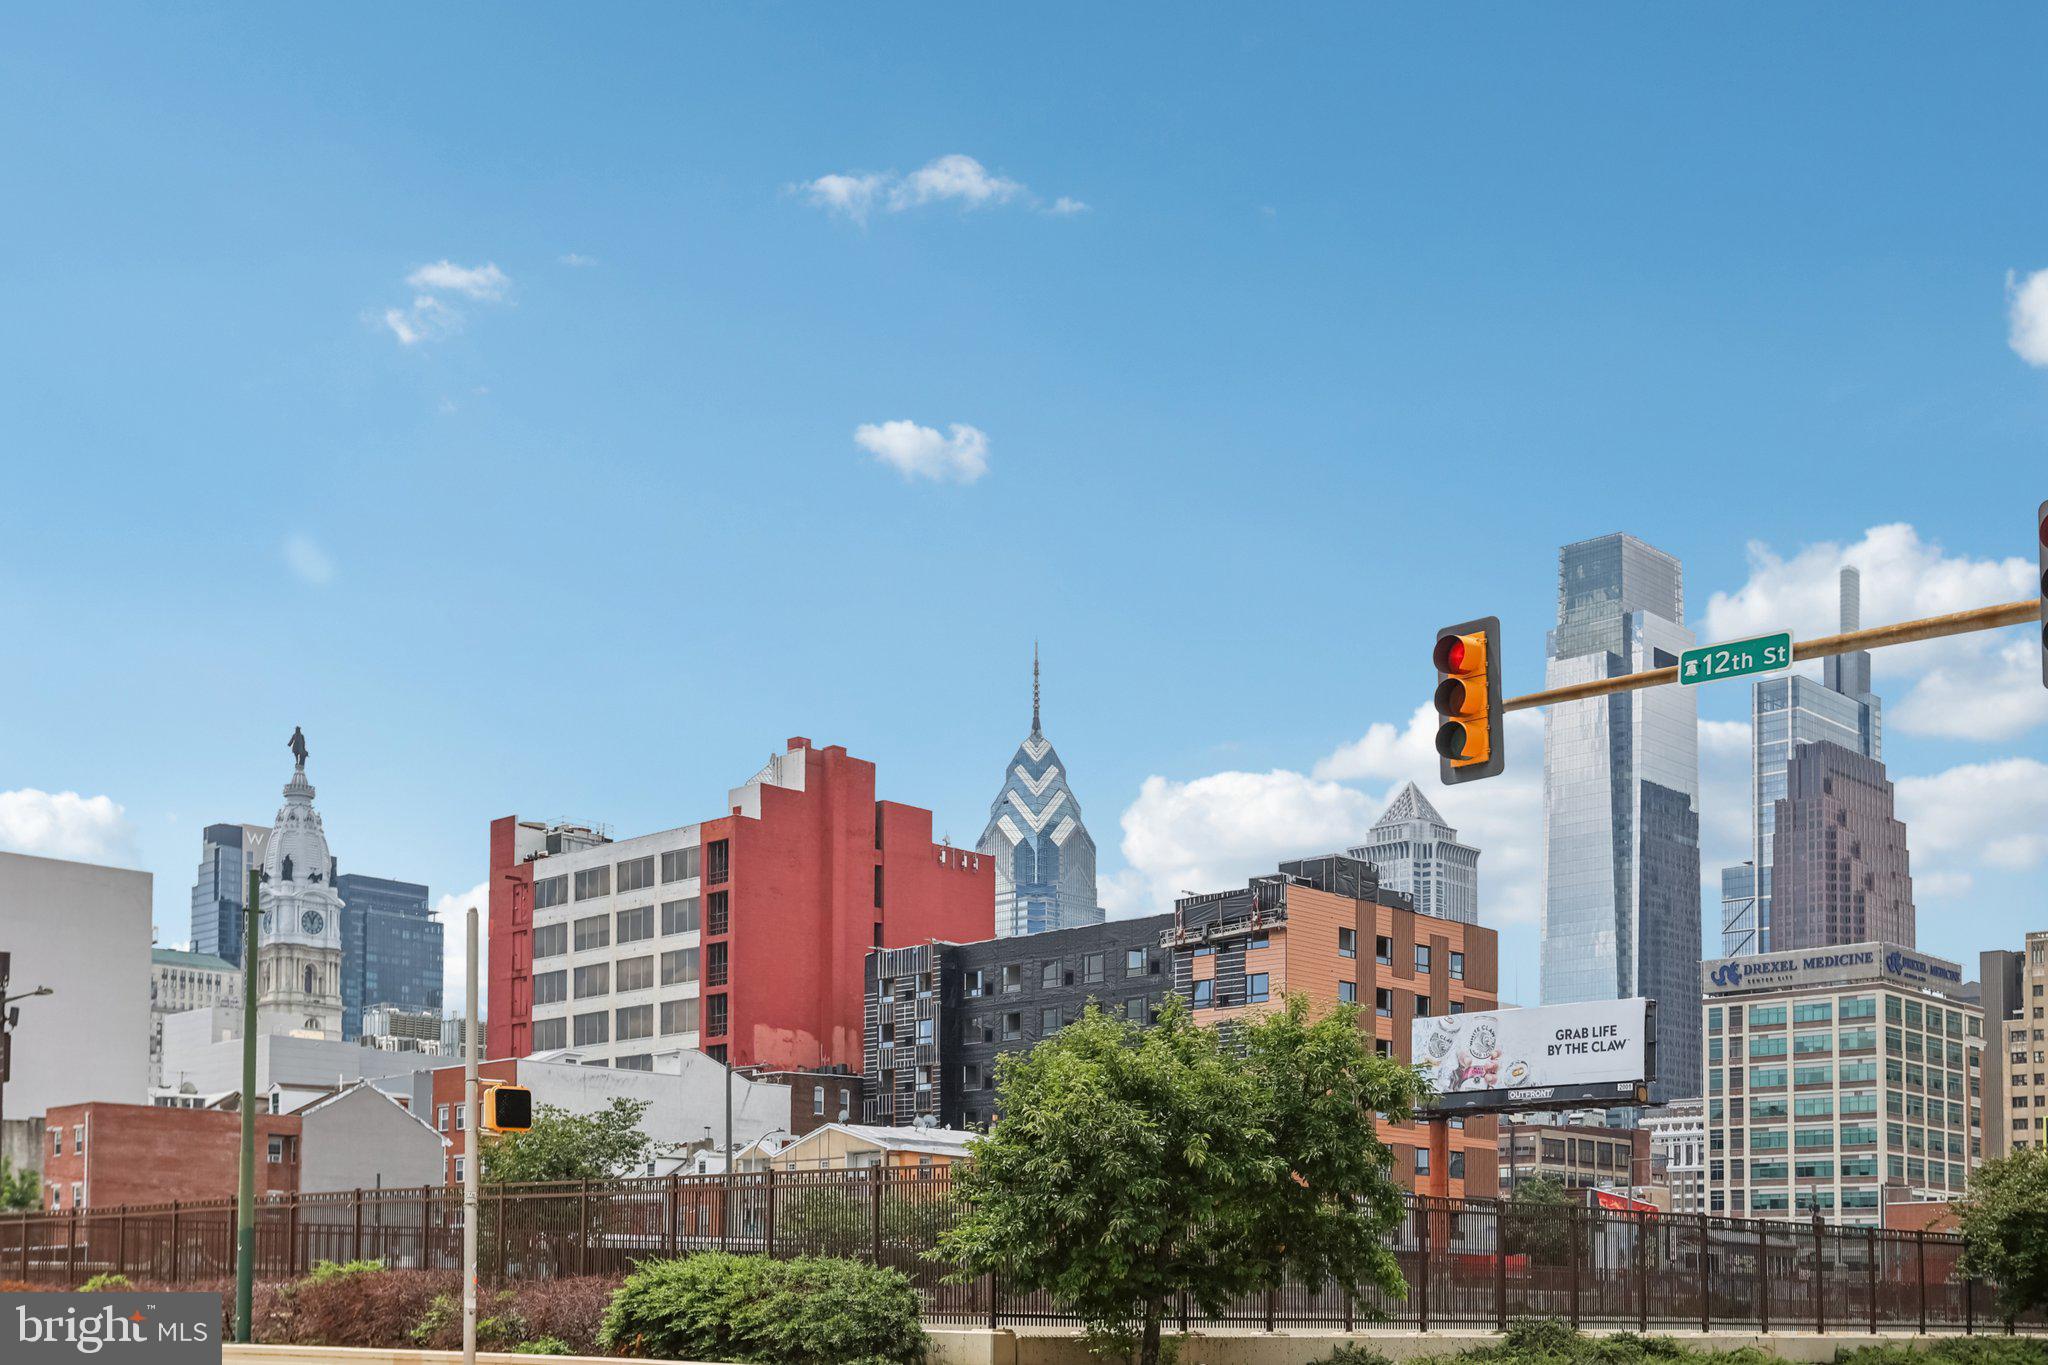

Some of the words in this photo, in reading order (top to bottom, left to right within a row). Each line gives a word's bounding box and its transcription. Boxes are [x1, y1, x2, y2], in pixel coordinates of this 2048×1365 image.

[1702, 651, 1753, 676] 12th
[1763, 646, 1786, 665] St
[246, 831, 264, 846] W
[1743, 960, 1797, 976] DREXEL
[1803, 951, 1873, 970] MEDICINE
[1555, 1027, 1589, 1041] GRAB
[1592, 1024, 1618, 1038] LIFE
[1547, 1043, 1562, 1056] BY
[1564, 1042, 1588, 1055] THE
[1591, 1038, 1627, 1053] CLAW
